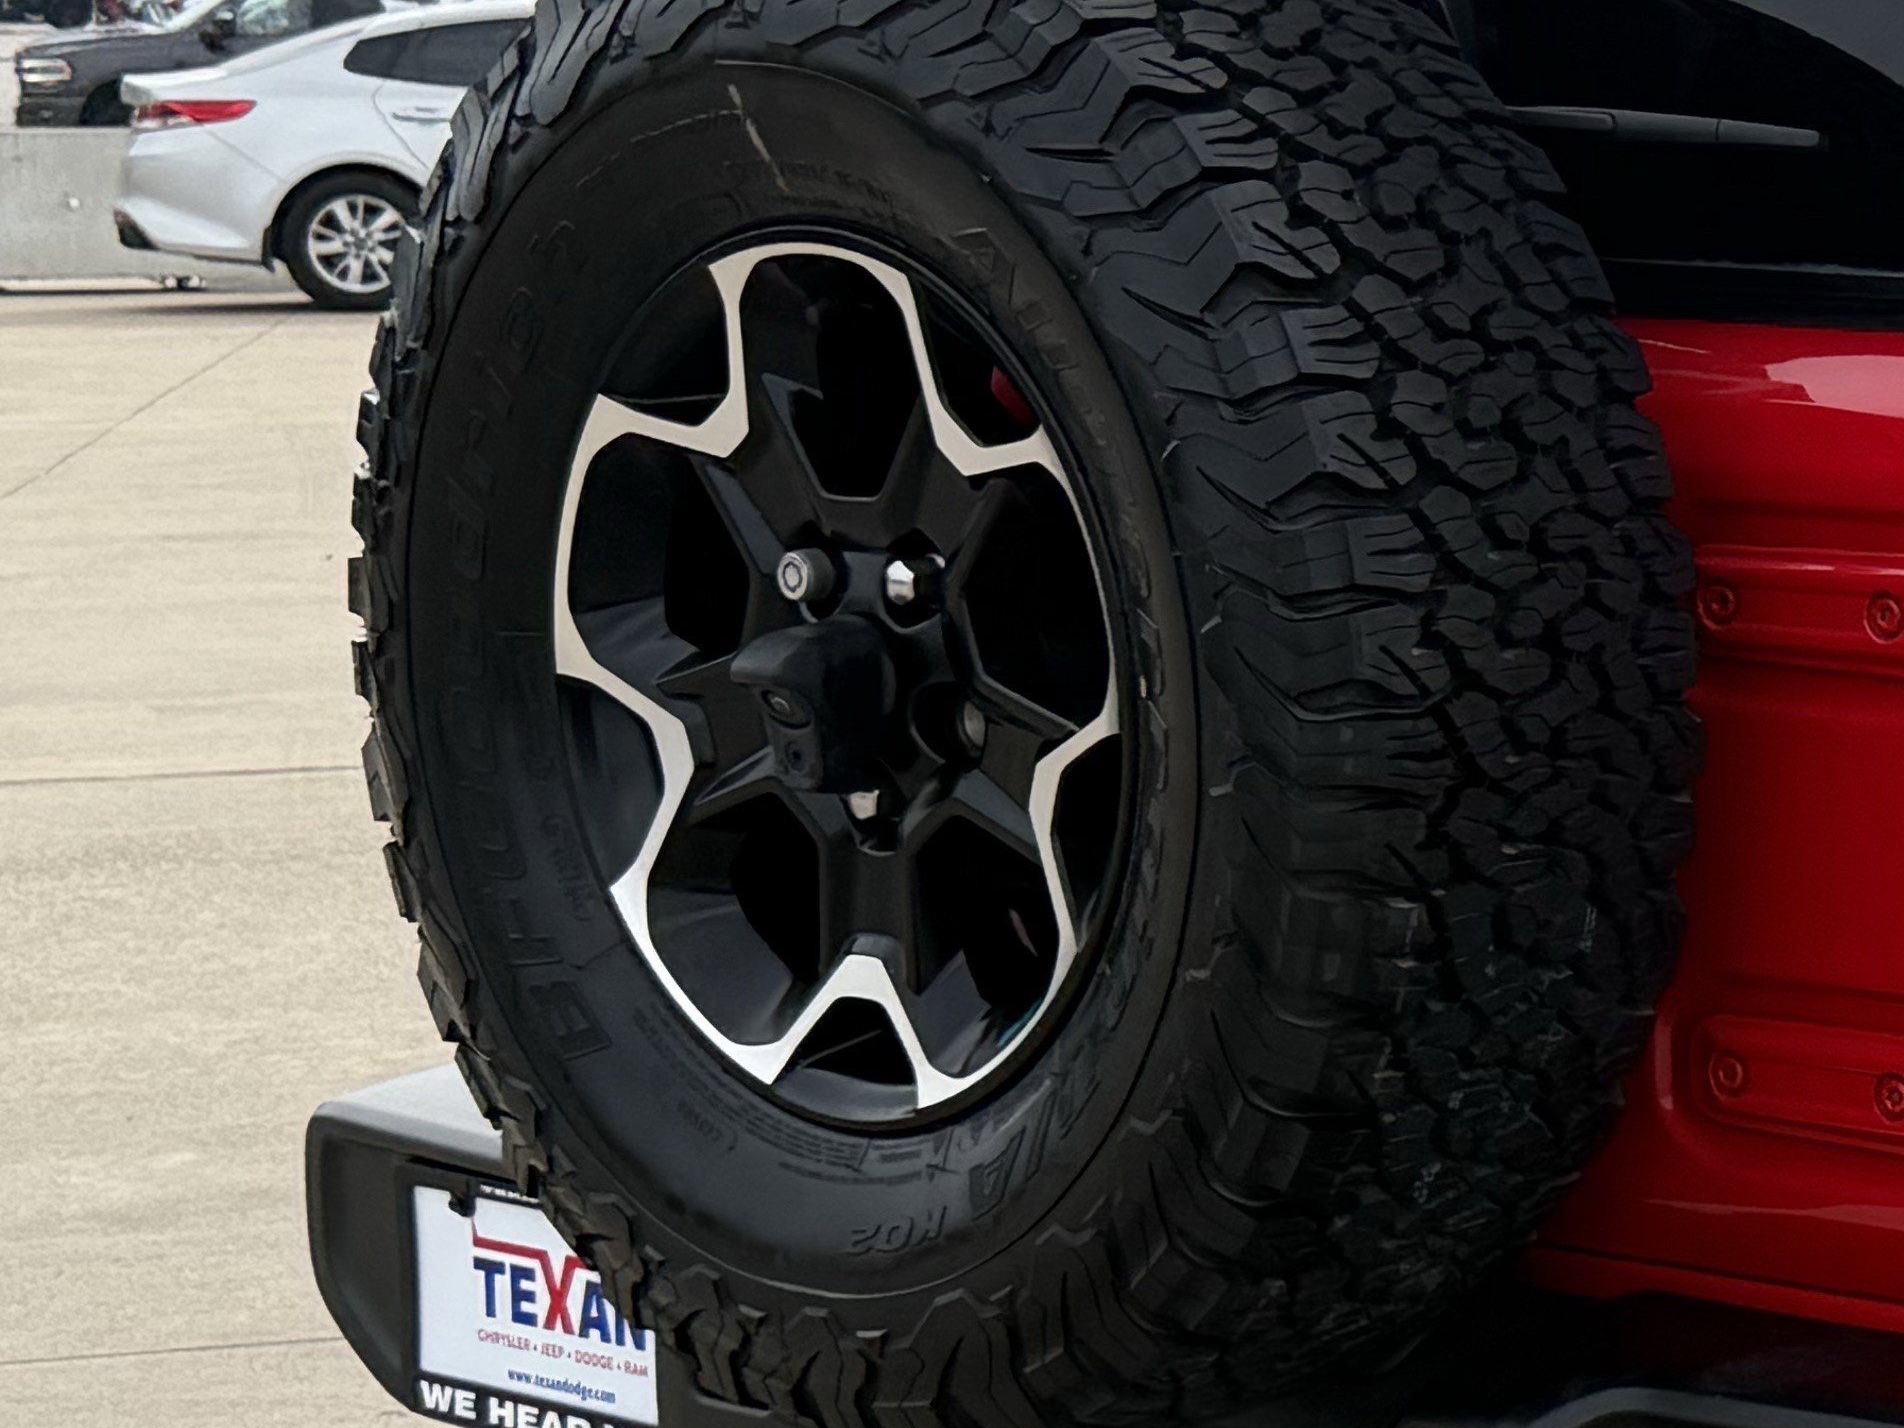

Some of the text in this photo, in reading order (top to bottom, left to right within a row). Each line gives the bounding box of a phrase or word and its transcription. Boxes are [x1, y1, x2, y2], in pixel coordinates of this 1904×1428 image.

[473, 1252, 646, 1351] TEXAN
[477, 1329, 649, 1377] CHRYSLER JEEP DODGE RAM
[420, 1380, 477, 1421] WE
[508, 1369, 616, 1402] www.texandodge.com
